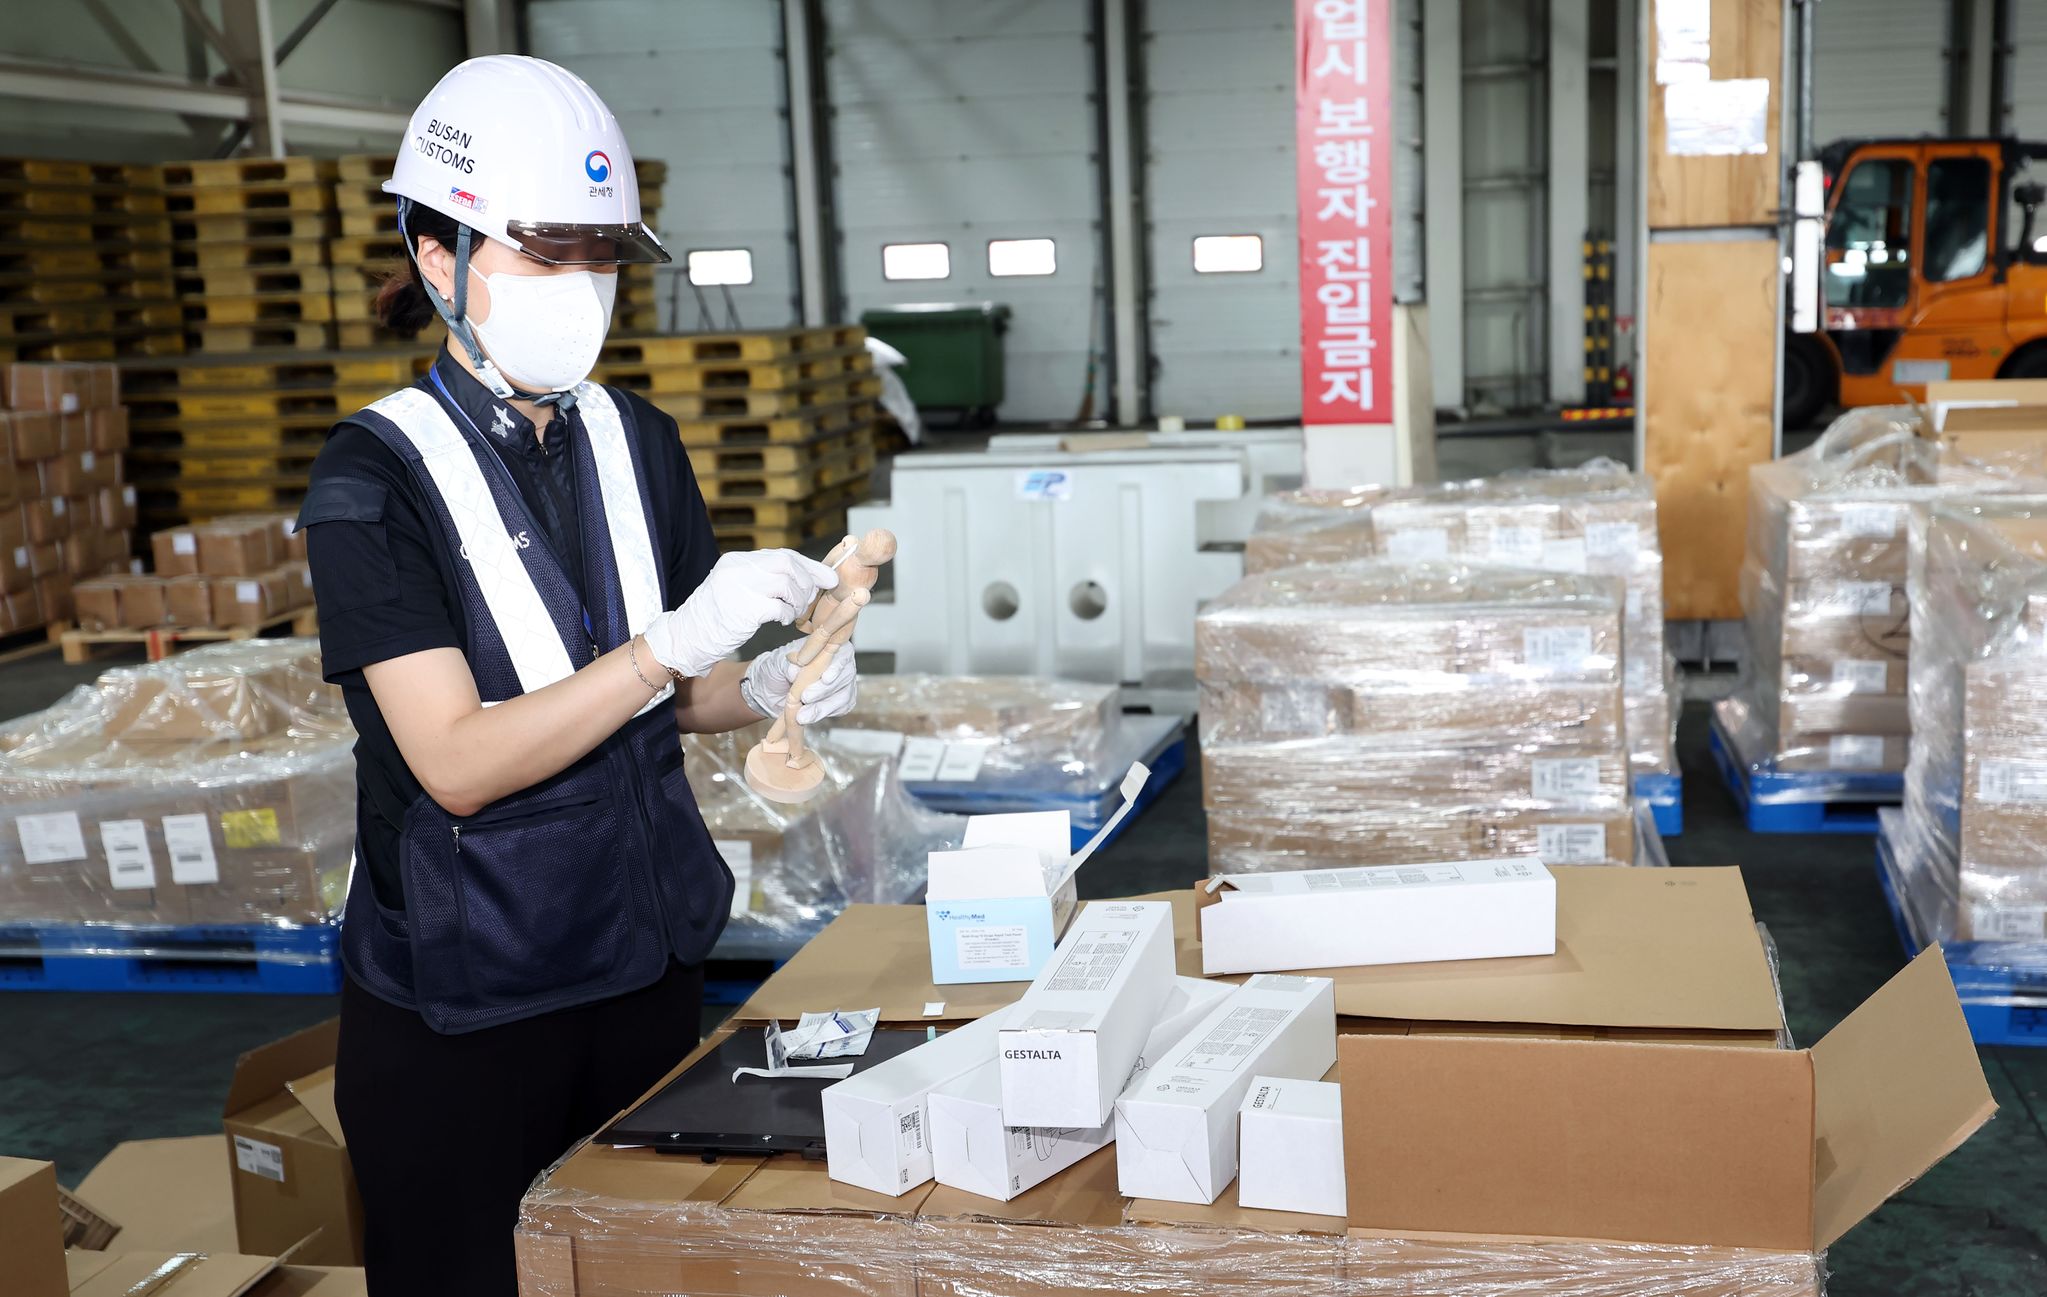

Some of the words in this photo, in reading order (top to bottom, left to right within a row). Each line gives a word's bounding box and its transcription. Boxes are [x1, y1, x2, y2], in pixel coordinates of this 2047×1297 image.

[427, 118, 473, 149] BUSAN
[414, 136, 475, 174] CUSTOMS
[1314, 98, 1376, 228] 보행자
[589, 186, 613, 198] 관세청
[1316, 237, 1377, 410] 진입금지
[1004, 1049, 1062, 1060] GESTALTA
[1252, 1086, 1270, 1108] GESTALTA
